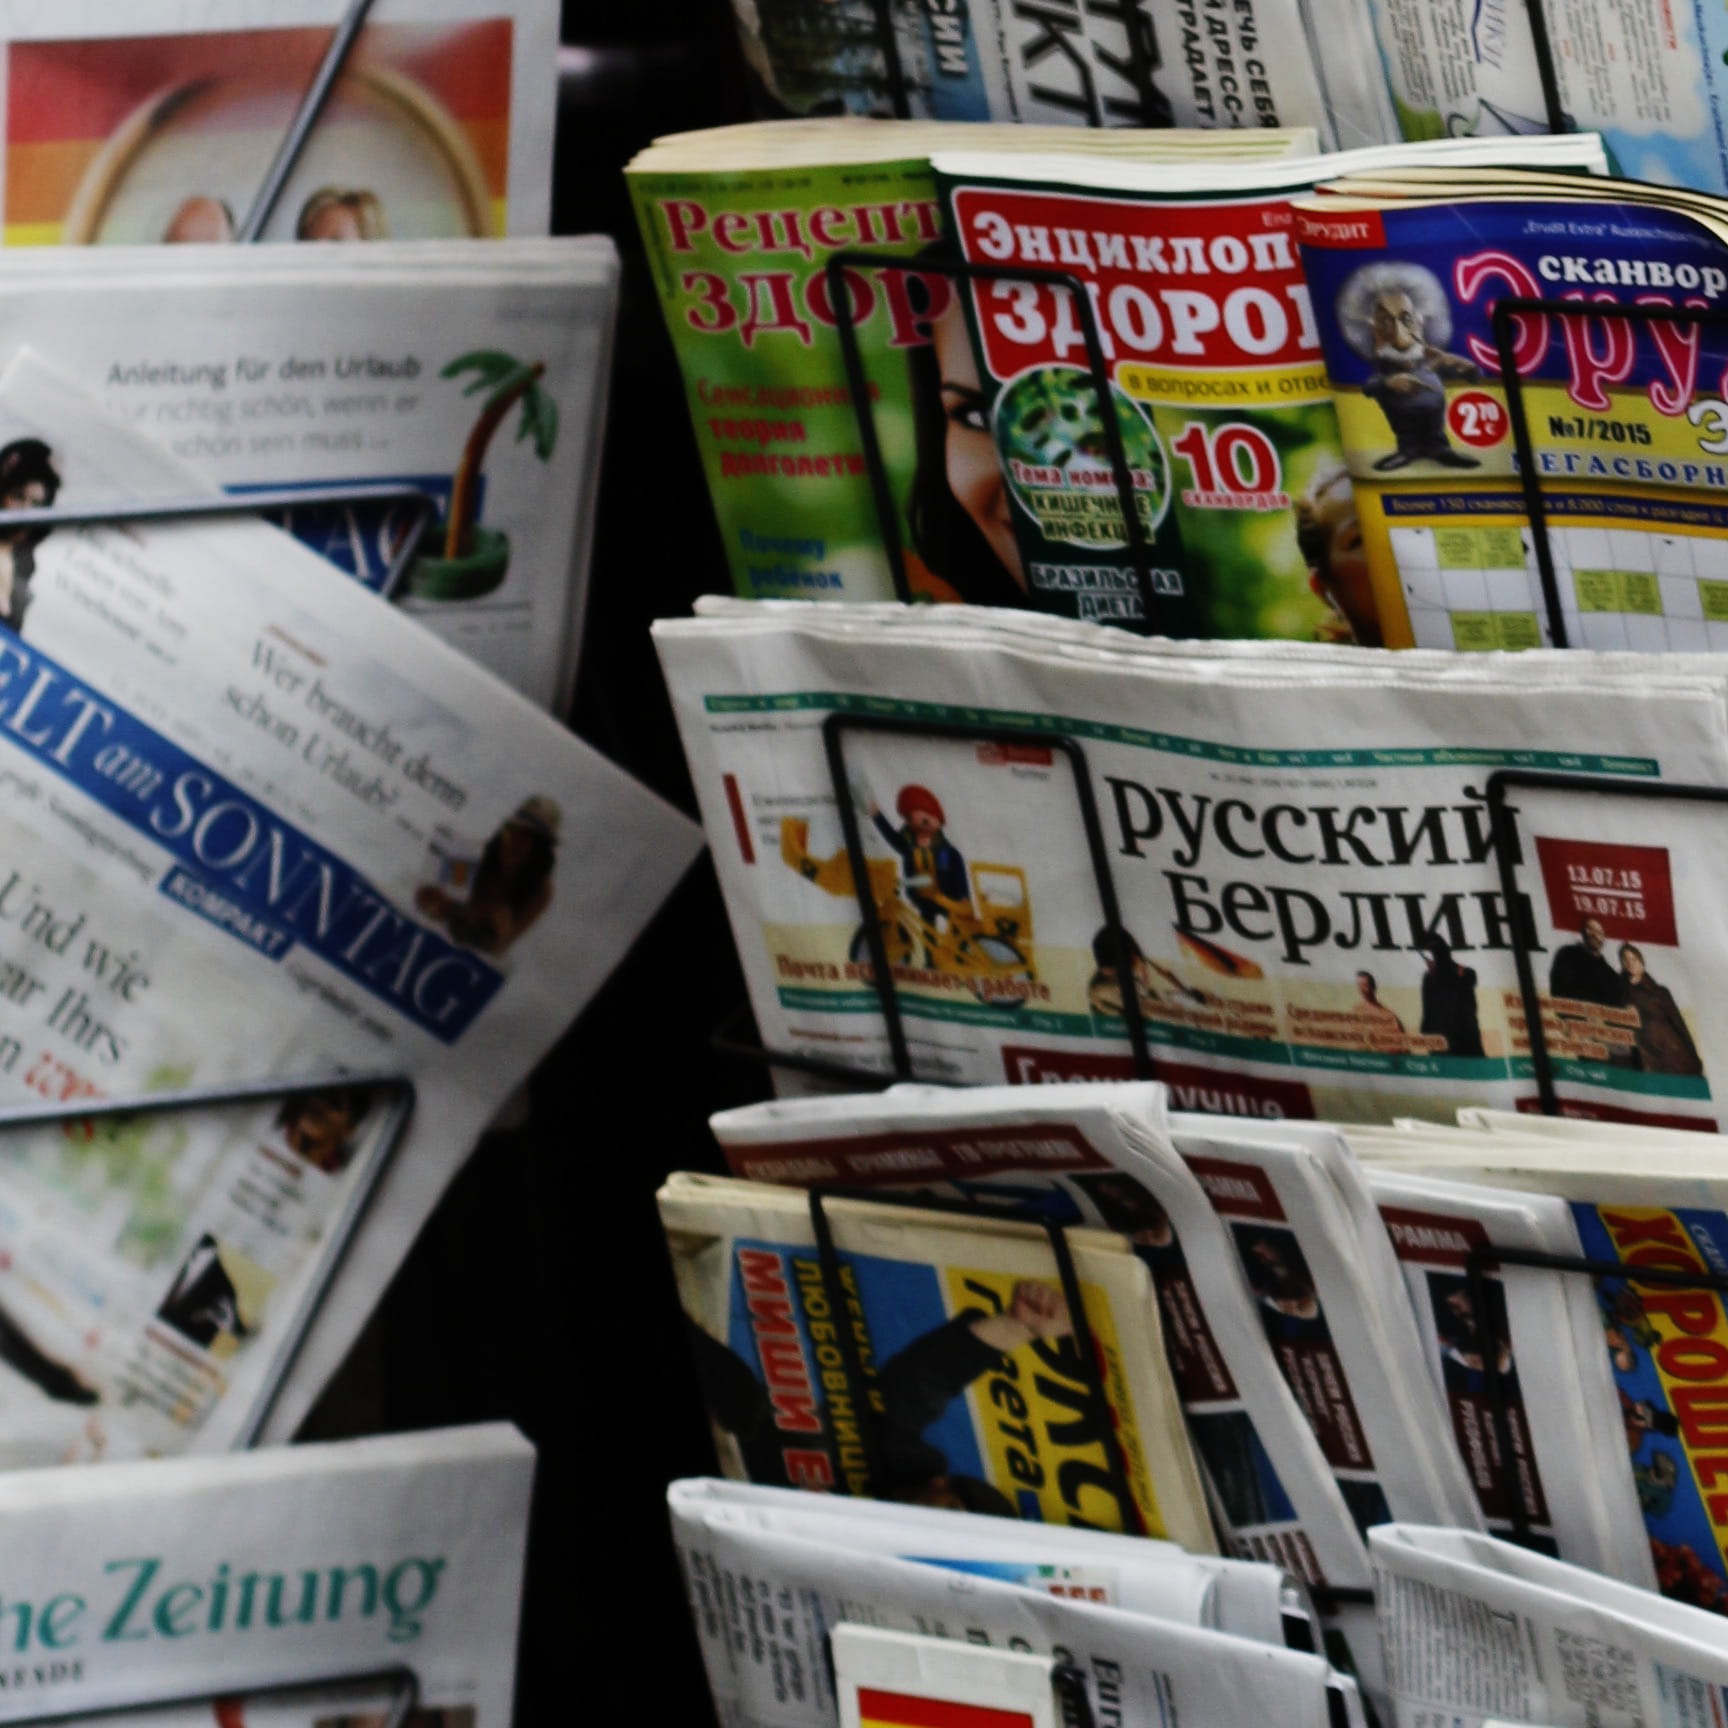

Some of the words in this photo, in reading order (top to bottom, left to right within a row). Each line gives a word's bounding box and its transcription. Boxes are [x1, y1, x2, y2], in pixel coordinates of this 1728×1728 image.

[1244, 58, 1282, 128] СЕБЯ
[658, 198, 943, 264] Рецепт
[106, 358, 228, 390] Anleitung
[235, 355, 278, 384] für
[284, 355, 328, 380] den
[333, 353, 424, 380] Urlaub
[1146, 370, 1249, 400] вопросах
[1549, 414, 1654, 446] №7/2015
[1172, 422, 1282, 498] 10
[1029, 491, 1152, 518] КИШЕЧНЕ
[1030, 564, 1184, 597] БРАЗИЛЬСАЯ
[149, 772, 483, 1029] SONNTAG
[1567, 861, 1644, 890] 13.07.15
[1163, 870, 1549, 968] Берлин
[1572, 893, 1648, 922] 19.07.15
[737, 1247, 824, 1434] МИШИ
[103, 1556, 449, 1645] Zeitung
